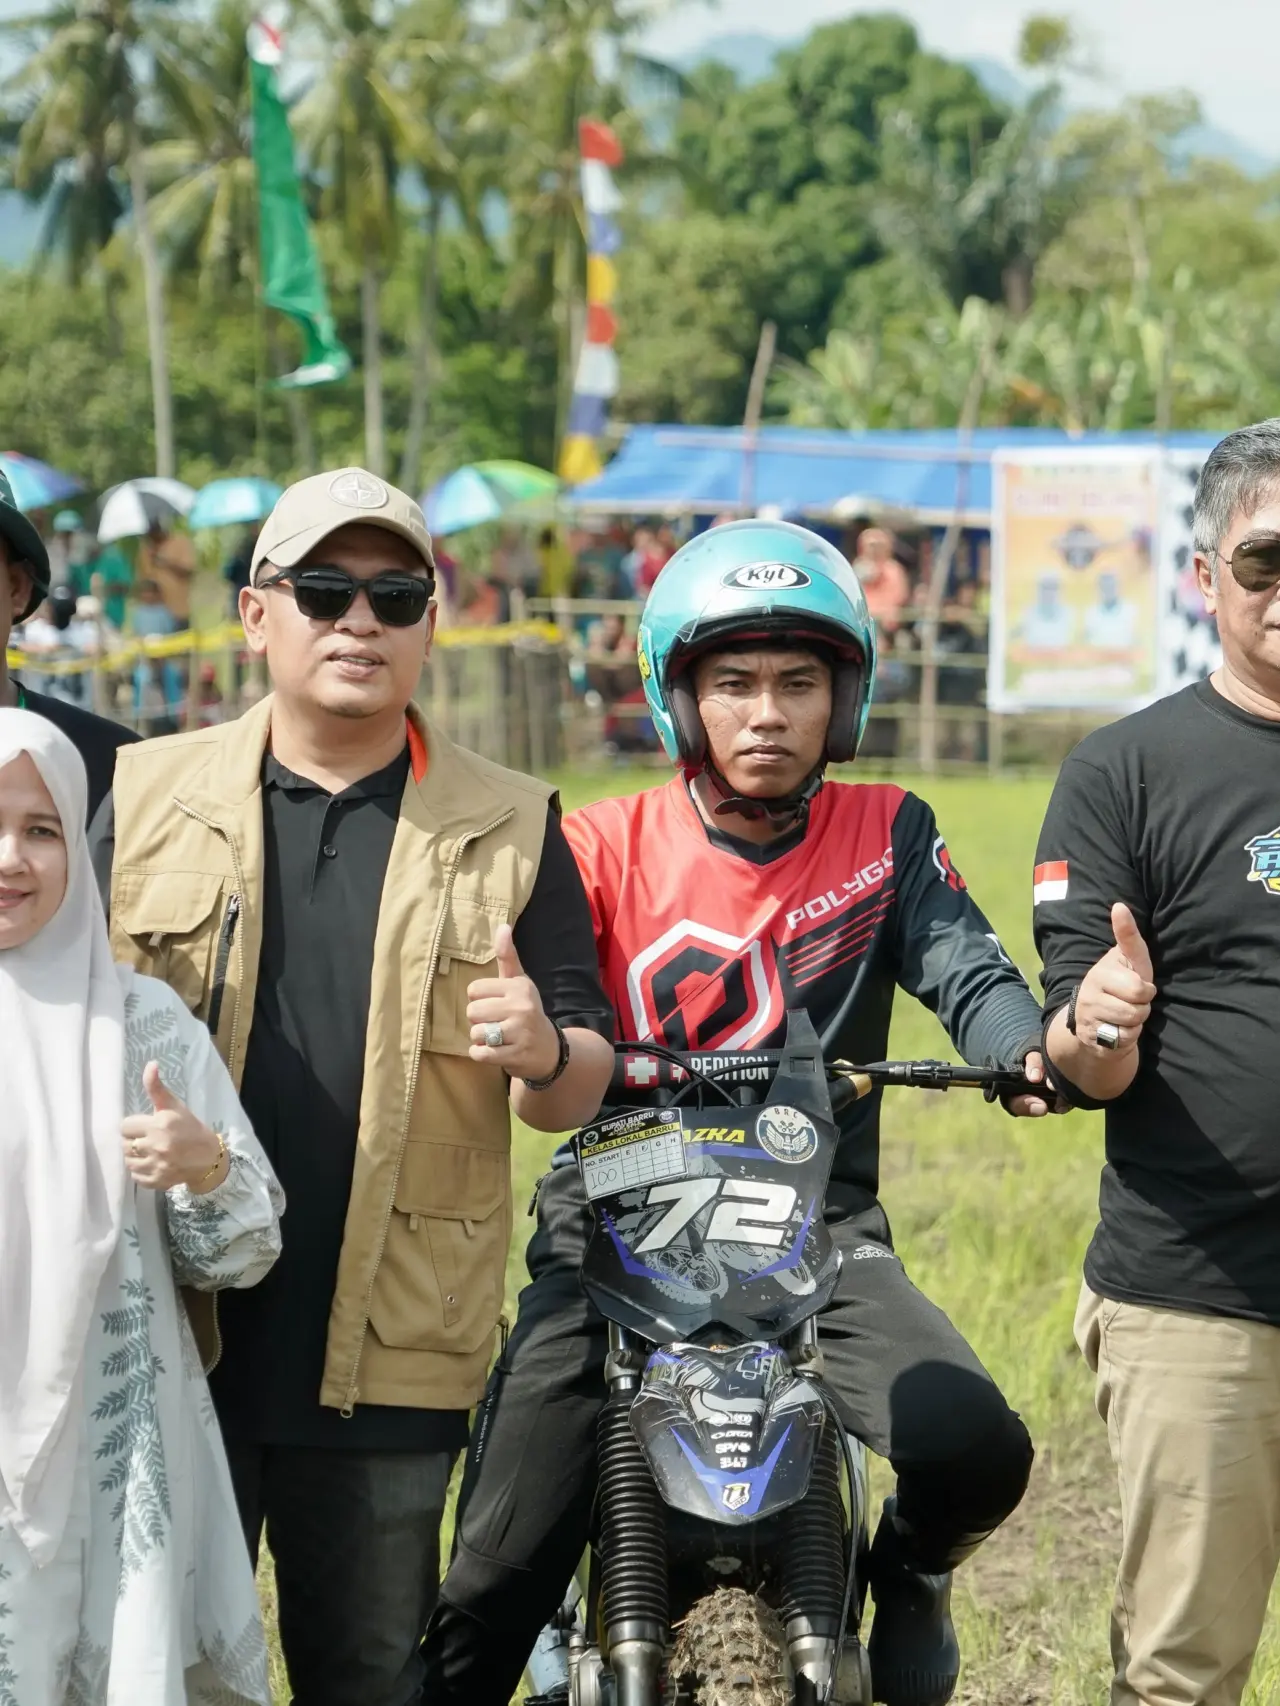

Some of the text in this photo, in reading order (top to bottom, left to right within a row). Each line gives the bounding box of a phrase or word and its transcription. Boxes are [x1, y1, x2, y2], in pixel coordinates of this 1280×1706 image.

[627, 1111, 654, 1124] BARRU
[587, 1142, 614, 1154] KELAS
[615, 1134, 643, 1145] LOKAL
[644, 1124, 674, 1137] BARRU
[598, 1153, 620, 1164] START
[591, 1168, 617, 1190] 100
[633, 1178, 797, 1254] 72
